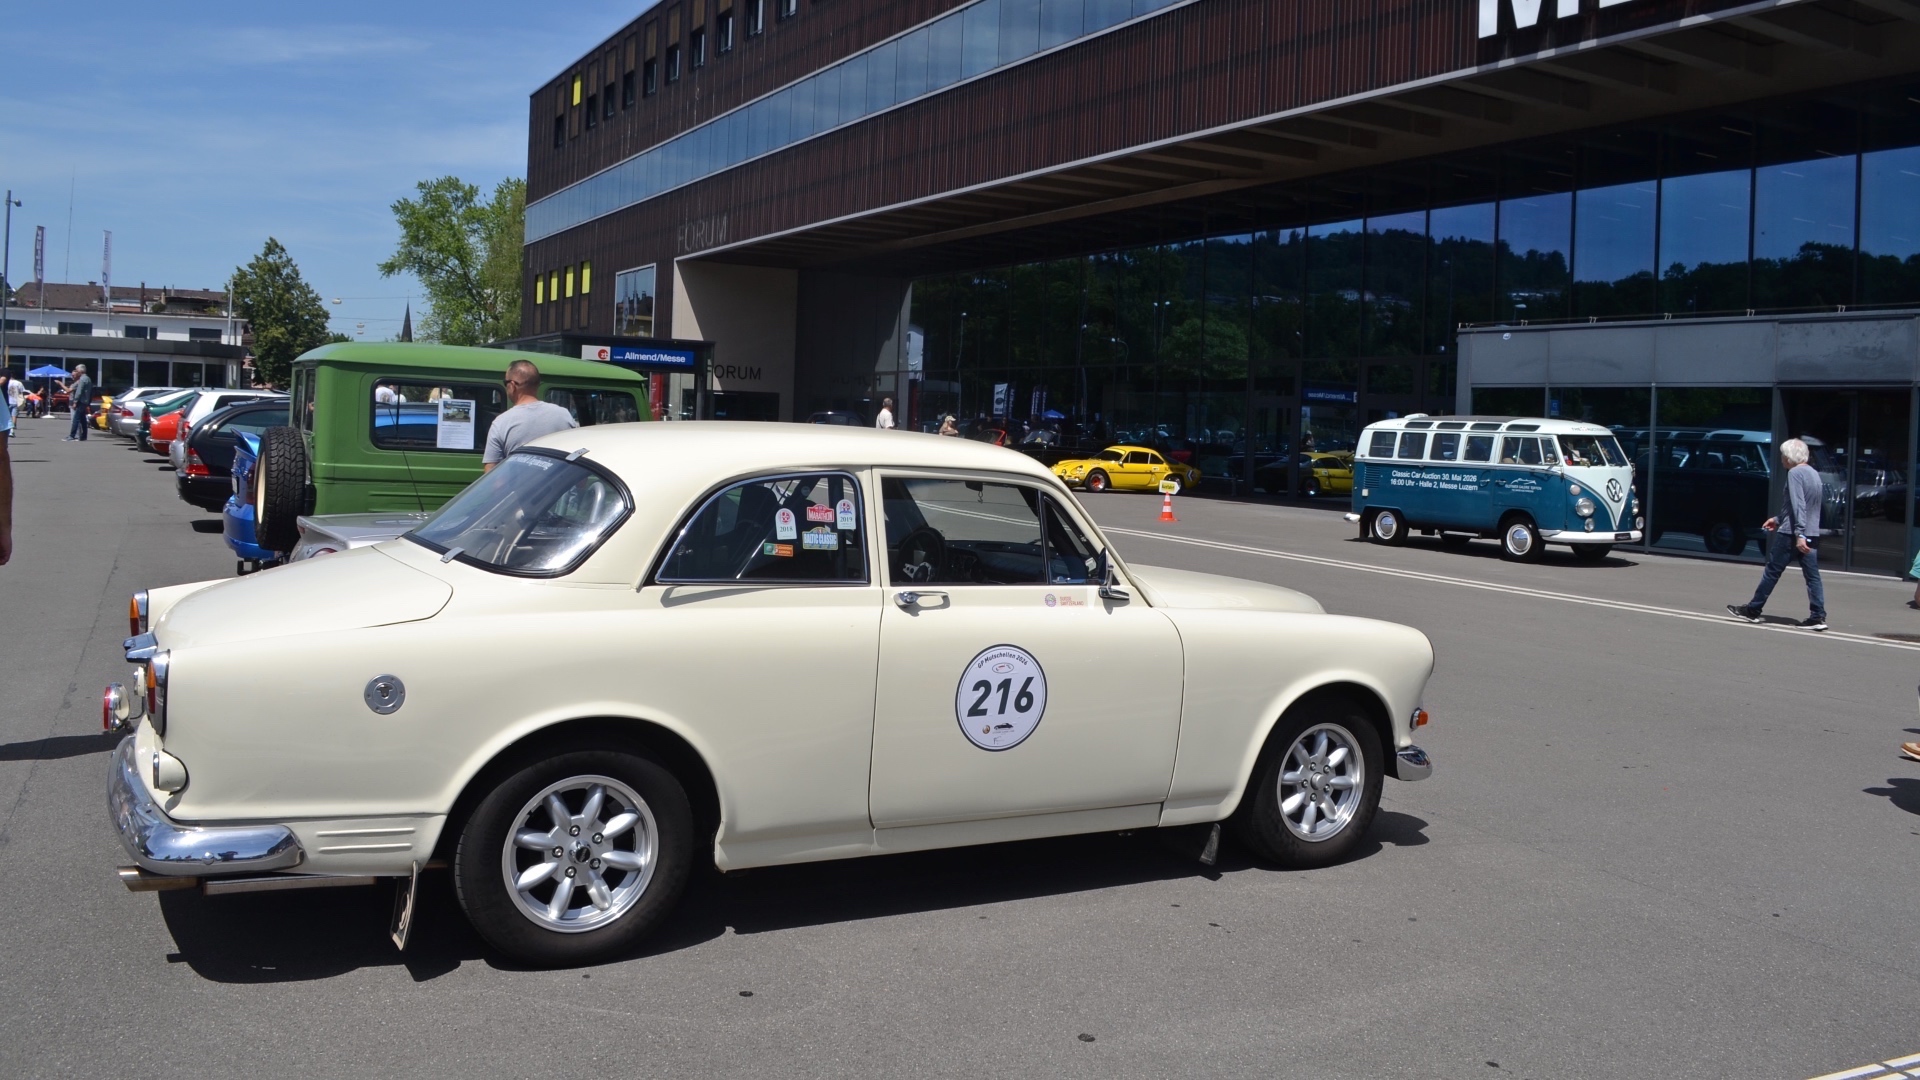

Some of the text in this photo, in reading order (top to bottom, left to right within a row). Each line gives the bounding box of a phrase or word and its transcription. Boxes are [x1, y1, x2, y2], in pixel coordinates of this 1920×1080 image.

[624, 351, 686, 363] Allmend/Messe
[1391, 470, 1478, 482] Classic Car Auction 30. Mai 2026
[1405, 479, 1415, 487] Uhr
[1419, 481, 1433, 489] Halle
[1439, 482, 1458, 490] Messe
[1458, 482, 1479, 491] Luzern
[808, 509, 833, 522] MARATHON
[803, 533, 837, 545] BALTIC CLASSIC
[977, 651, 1029, 669] GP Mutschellen 2026
[966, 676, 1035, 718] 216
